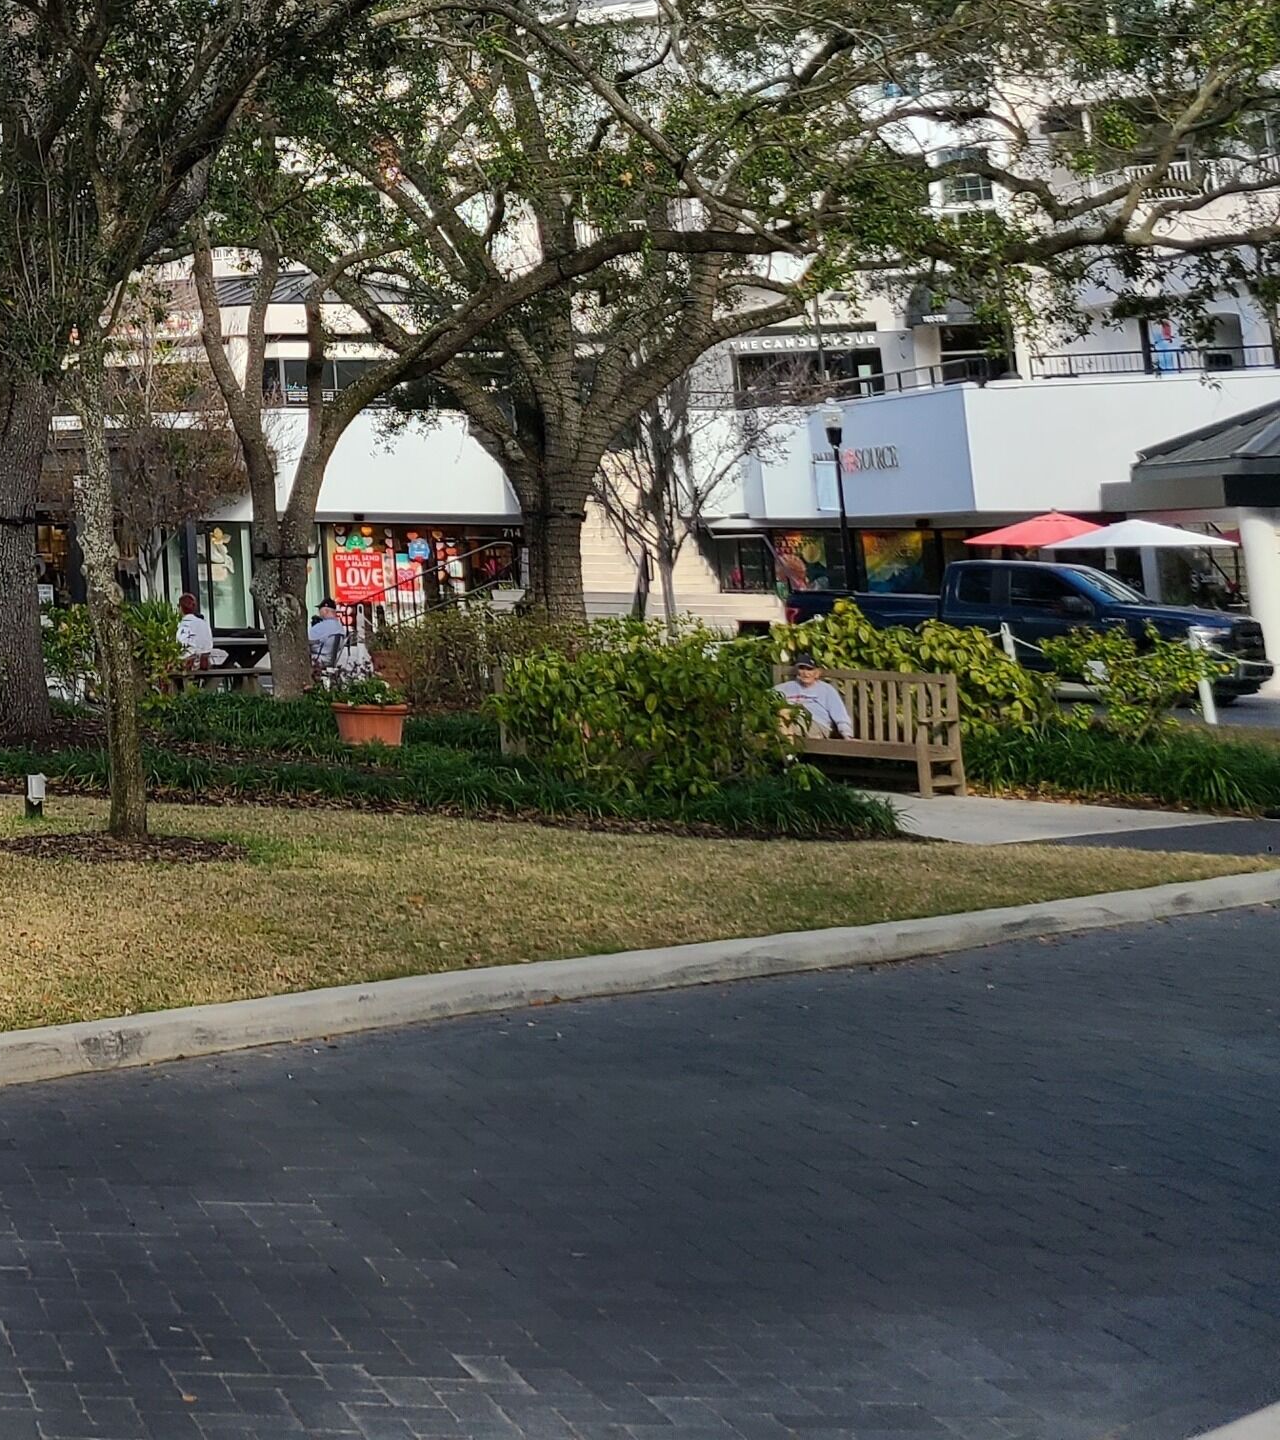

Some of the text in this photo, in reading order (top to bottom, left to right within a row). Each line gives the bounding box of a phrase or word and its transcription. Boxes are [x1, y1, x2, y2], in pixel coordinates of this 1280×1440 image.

[730, 340, 759, 351] THE
[854, 445, 900, 471] SOURCE
[502, 527, 521, 538] 714
[335, 566, 384, 587] LOVE
